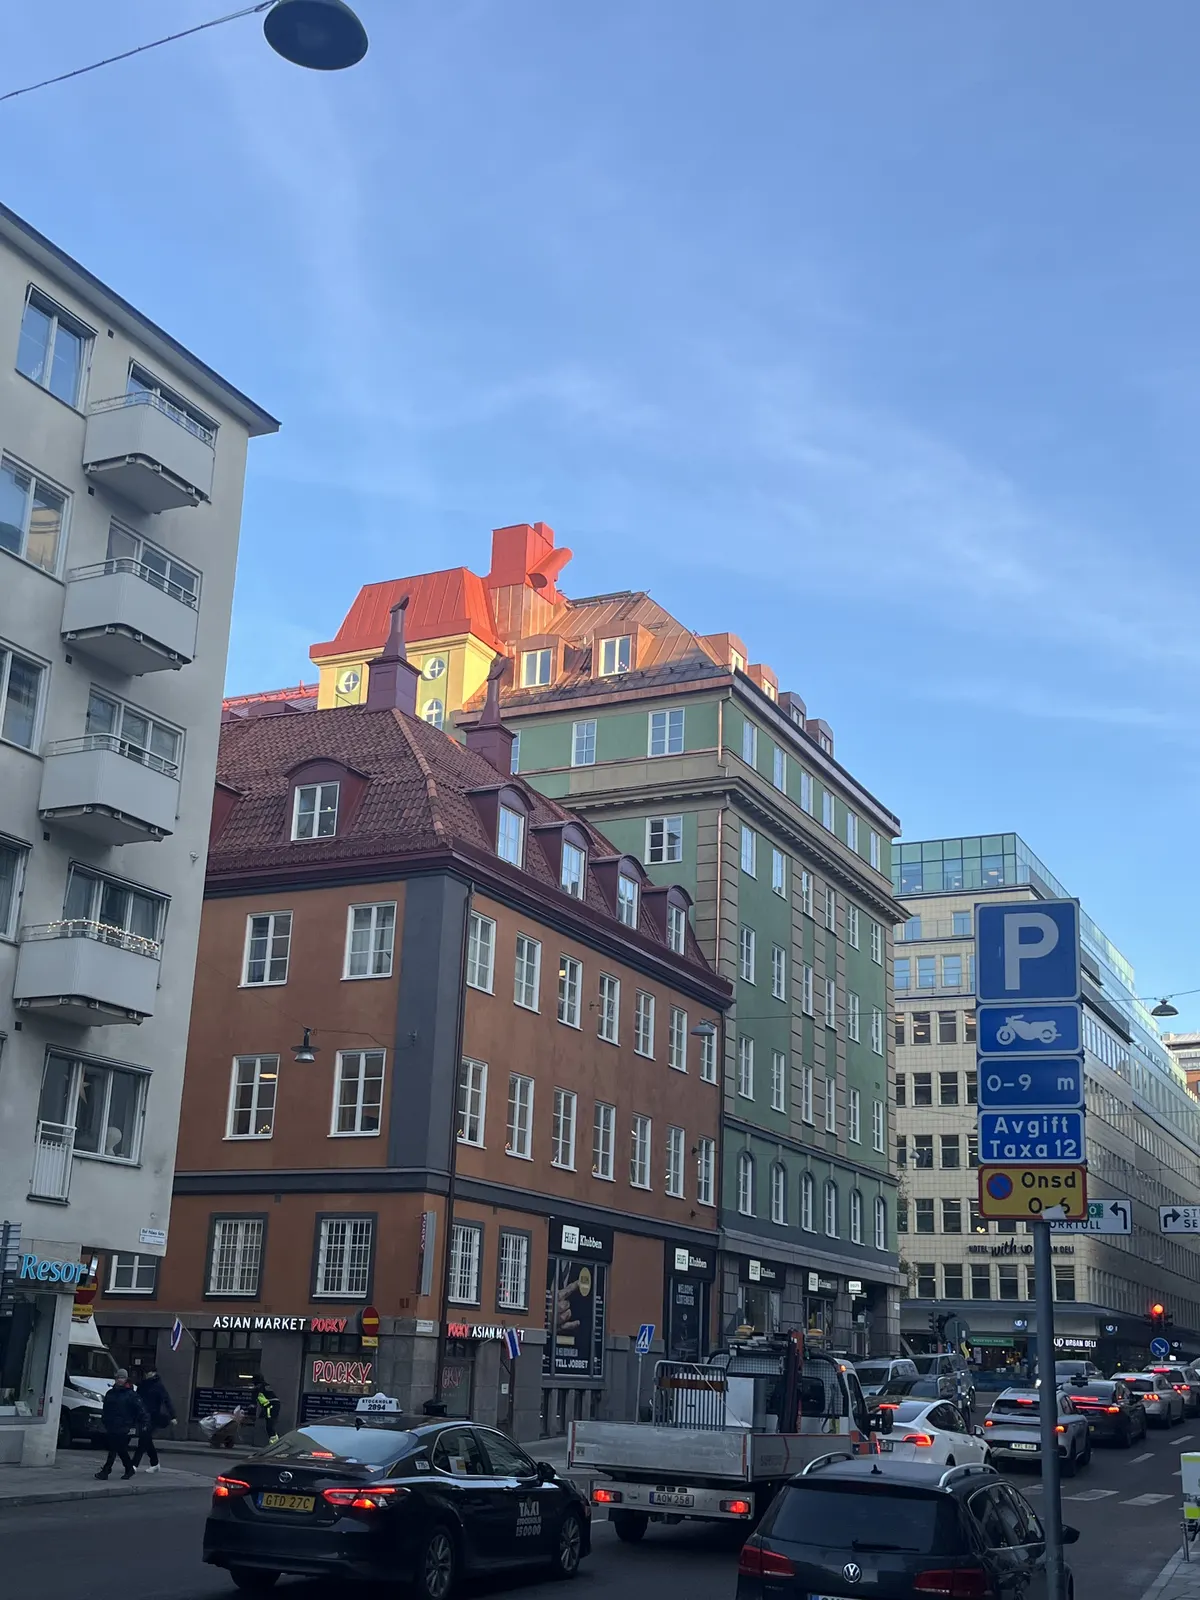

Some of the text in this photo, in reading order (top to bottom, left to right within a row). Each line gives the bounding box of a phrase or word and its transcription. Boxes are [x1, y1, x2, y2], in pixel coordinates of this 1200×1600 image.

[1004, 912, 1059, 990] P
[986, 1073, 1075, 1092] 0-9 m
[993, 1116, 1069, 1138] Avgift
[989, 1139, 1077, 1158] Taxa 12
[1021, 1171, 1076, 1189] Onsd
[1183, 1208, 1200, 1218] ST
[1050, 1219, 1101, 1230] ORRTULL
[579, 1234, 603, 1249] Klubben
[991, 1237, 1017, 1257] with
[20, 1253, 88, 1284] Resor
[213, 1315, 348, 1333] ASIAN MARKET POCKY
[448, 1322, 469, 1338] POCKY
[471, 1325, 495, 1338] ASIAN
[1065, 1339, 1084, 1347] URBAN
[1084, 1340, 1097, 1348] DELI
[312, 1359, 373, 1385] POCKY
[265, 1495, 311, 1509] GTD 27C
[518, 1501, 540, 1517] TAXI
[674, 1495, 690, 1505] 258
